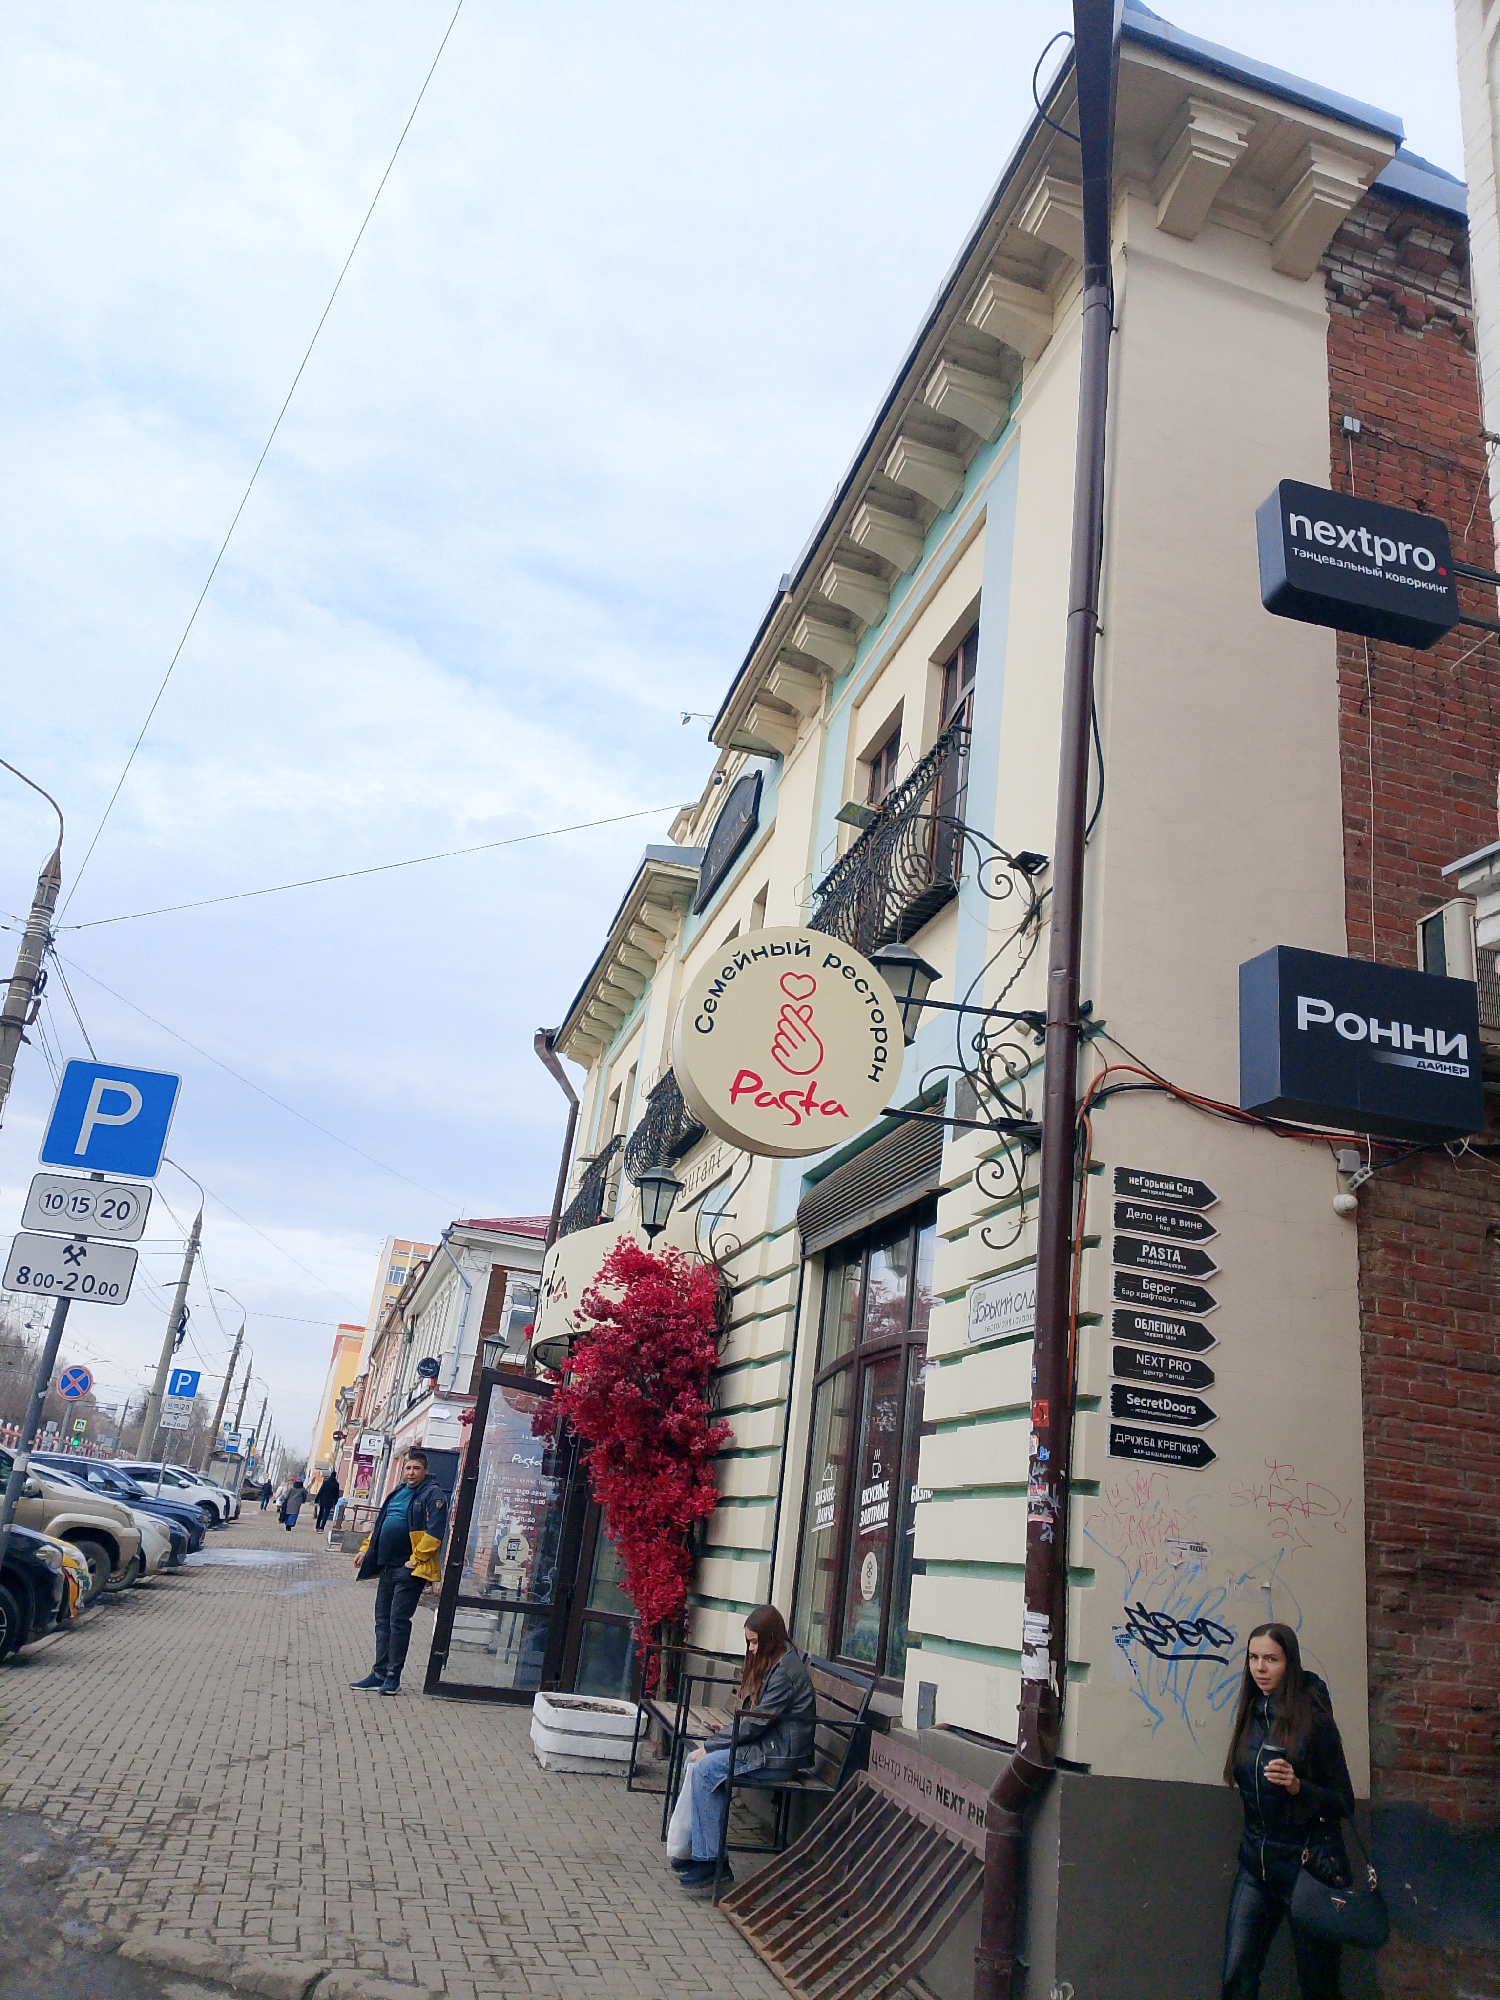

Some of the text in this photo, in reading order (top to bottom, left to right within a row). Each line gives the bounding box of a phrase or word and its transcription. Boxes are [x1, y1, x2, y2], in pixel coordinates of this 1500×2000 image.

[1292, 546, 1449, 594] танцевальный коворкинг
[693, 937, 889, 1083] Семейный ресторан
[1416, 1059, 1468, 1076] ДАЙНЕР
[728, 1069, 850, 1126] Pasta
[1176, 1182, 1195, 1196] Сад
[43, 1193, 131, 1221] 10 15 20
[1125, 1207, 1203, 1230] Дело не в вине
[1141, 1244, 1182, 1263] PASTA
[1142, 1278, 1177, 1295] Берег
[1136, 1290, 1179, 1304] крафтового
[1179, 1298, 1197, 1308] пива
[1134, 1317, 1188, 1337] ОБЛЕПИХА
[1136, 1353, 1192, 1373] NEXT PRO
[1142, 1369, 1164, 1379] центр
[1126, 1393, 1197, 1415] SecretDoors
[1114, 1432, 1156, 1448] ДРУЖБА
[871, 1749, 987, 1829] центр танца NEXT PR
